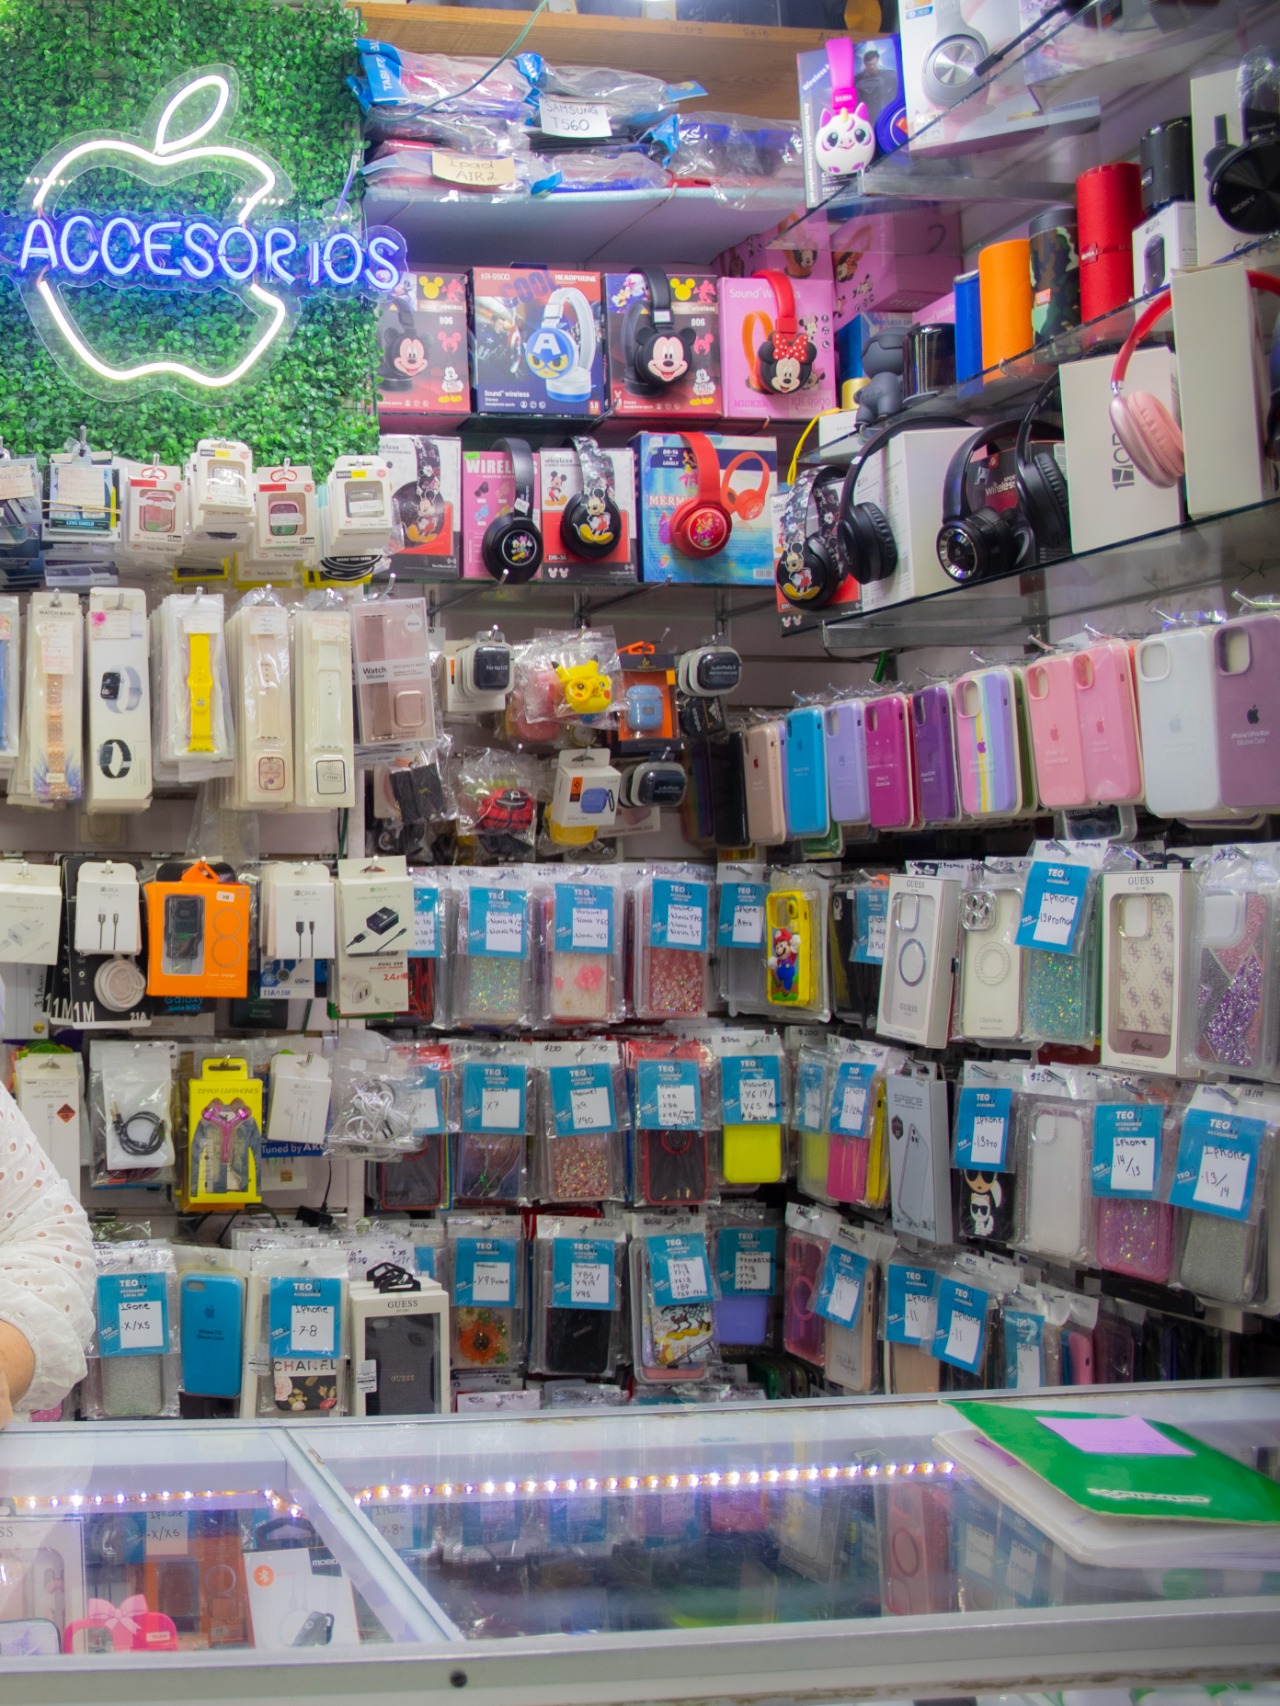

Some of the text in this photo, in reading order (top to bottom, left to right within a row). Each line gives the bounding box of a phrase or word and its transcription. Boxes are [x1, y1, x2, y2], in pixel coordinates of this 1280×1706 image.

[545, 101, 600, 117] SAMSUNG
[552, 118, 590, 133] T560
[19, 215, 402, 291] ACCESORIOS
[480, 273, 510, 282] KR-9900
[555, 274, 597, 283] HEADPHONE
[730, 288, 760, 299] Sound
[439, 316, 454, 325] 806
[691, 318, 706, 327] 806
[507, 390, 530, 399] wireless
[466, 459, 538, 475] WIRELS
[363, 667, 387, 675] Watch
[1048, 869, 1064, 877] TEO
[907, 881, 925, 889] GUESS
[1128, 877, 1154, 886] GUESS
[74, 1002, 95, 1022] 1M
[900, 1003, 918, 1013] GUESS
[570, 1069, 586, 1077] TEO
[1031, 1073, 1053, 1083] $250
[894, 1094, 923, 1105] SPACE
[976, 1093, 990, 1101] TEO
[1116, 1111, 1134, 1120] TEO
[1210, 1118, 1231, 1130] TEO
[1207, 1130, 1238, 1139] ACCESORIOS
[261, 1144, 286, 1154] Tuned
[289, 1144, 301, 1155] by
[666, 1239, 682, 1247] TEO
[906, 1272, 921, 1281] TEO
[120, 1279, 138, 1288] TEO
[293, 1283, 313, 1291] TEO
[955, 1288, 968, 1298] TEO
[388, 1300, 418, 1309] GUESS
[274, 1360, 337, 1372] CHANEL
[312, 1558, 341, 1568] MOBO
